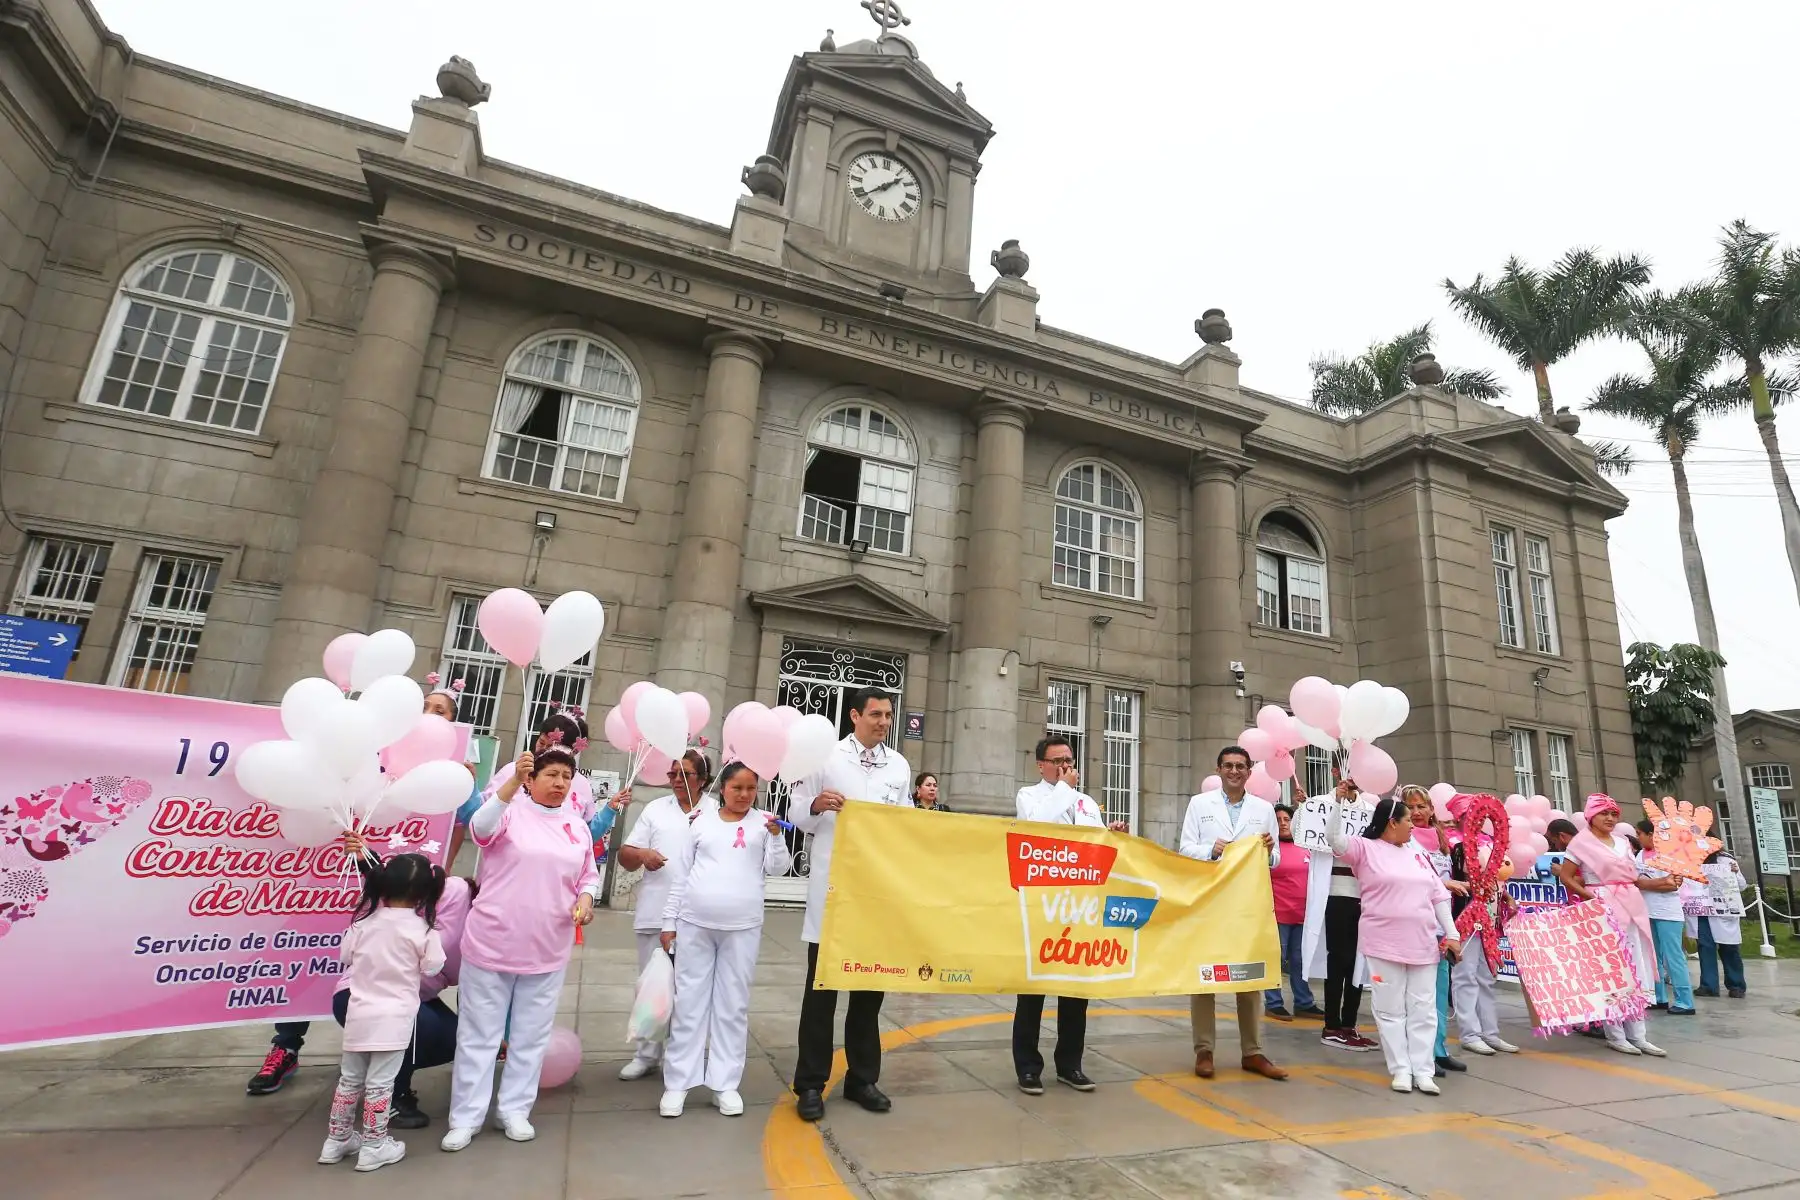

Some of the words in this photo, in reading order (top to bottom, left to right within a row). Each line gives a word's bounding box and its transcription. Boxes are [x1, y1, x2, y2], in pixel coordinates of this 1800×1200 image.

[473, 223, 692, 296] SOCIEDAD
[734, 294, 780, 319] DE
[819, 316, 1062, 397] BENEFICENCIA
[1088, 391, 1207, 438] PUBLICA
[231, 803, 280, 835] de
[128, 839, 270, 875] Contra
[273, 845, 312, 875] el
[1020, 842, 1078, 863] Decide
[192, 880, 245, 913] de
[247, 880, 360, 913] Mama
[1506, 883, 1568, 904] ONTRA
[1108, 901, 1138, 923] sin
[134, 934, 231, 955] Servicio
[239, 932, 266, 949] de
[273, 930, 348, 949] Gineco
[1534, 929, 1571, 947] QUE
[1572, 919, 1604, 942] NO
[1040, 927, 1128, 967] cáncer
[1556, 933, 1620, 962] SOBRE
[287, 962, 302, 979] y
[940, 971, 972, 983] LIMA
[228, 987, 288, 1007] HNAL
